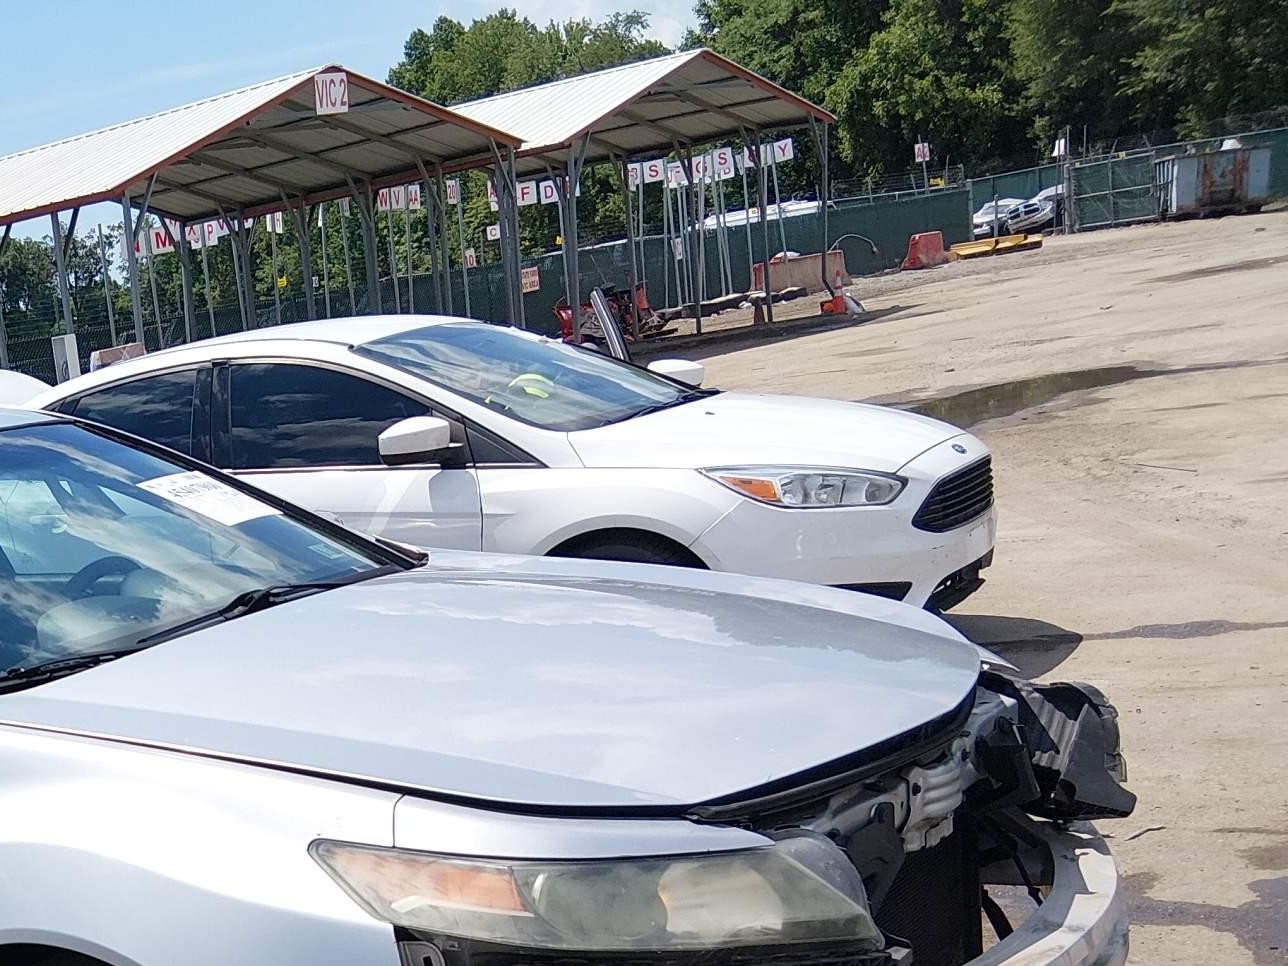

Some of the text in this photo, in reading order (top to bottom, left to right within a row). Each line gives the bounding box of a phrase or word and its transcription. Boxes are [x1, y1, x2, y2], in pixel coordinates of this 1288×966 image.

[316, 79, 347, 108] VIC 2
[778, 144, 788, 157] Y
[718, 152, 728, 166] S
[648, 165, 659, 177] S
[392, 191, 400, 205] V
[408, 190, 419, 204] AA
[448, 184, 456, 200] 20
[521, 186, 530, 201] F
[544, 185, 554, 199] D
[490, 228, 497, 237] C
[155, 232, 172, 249] M
